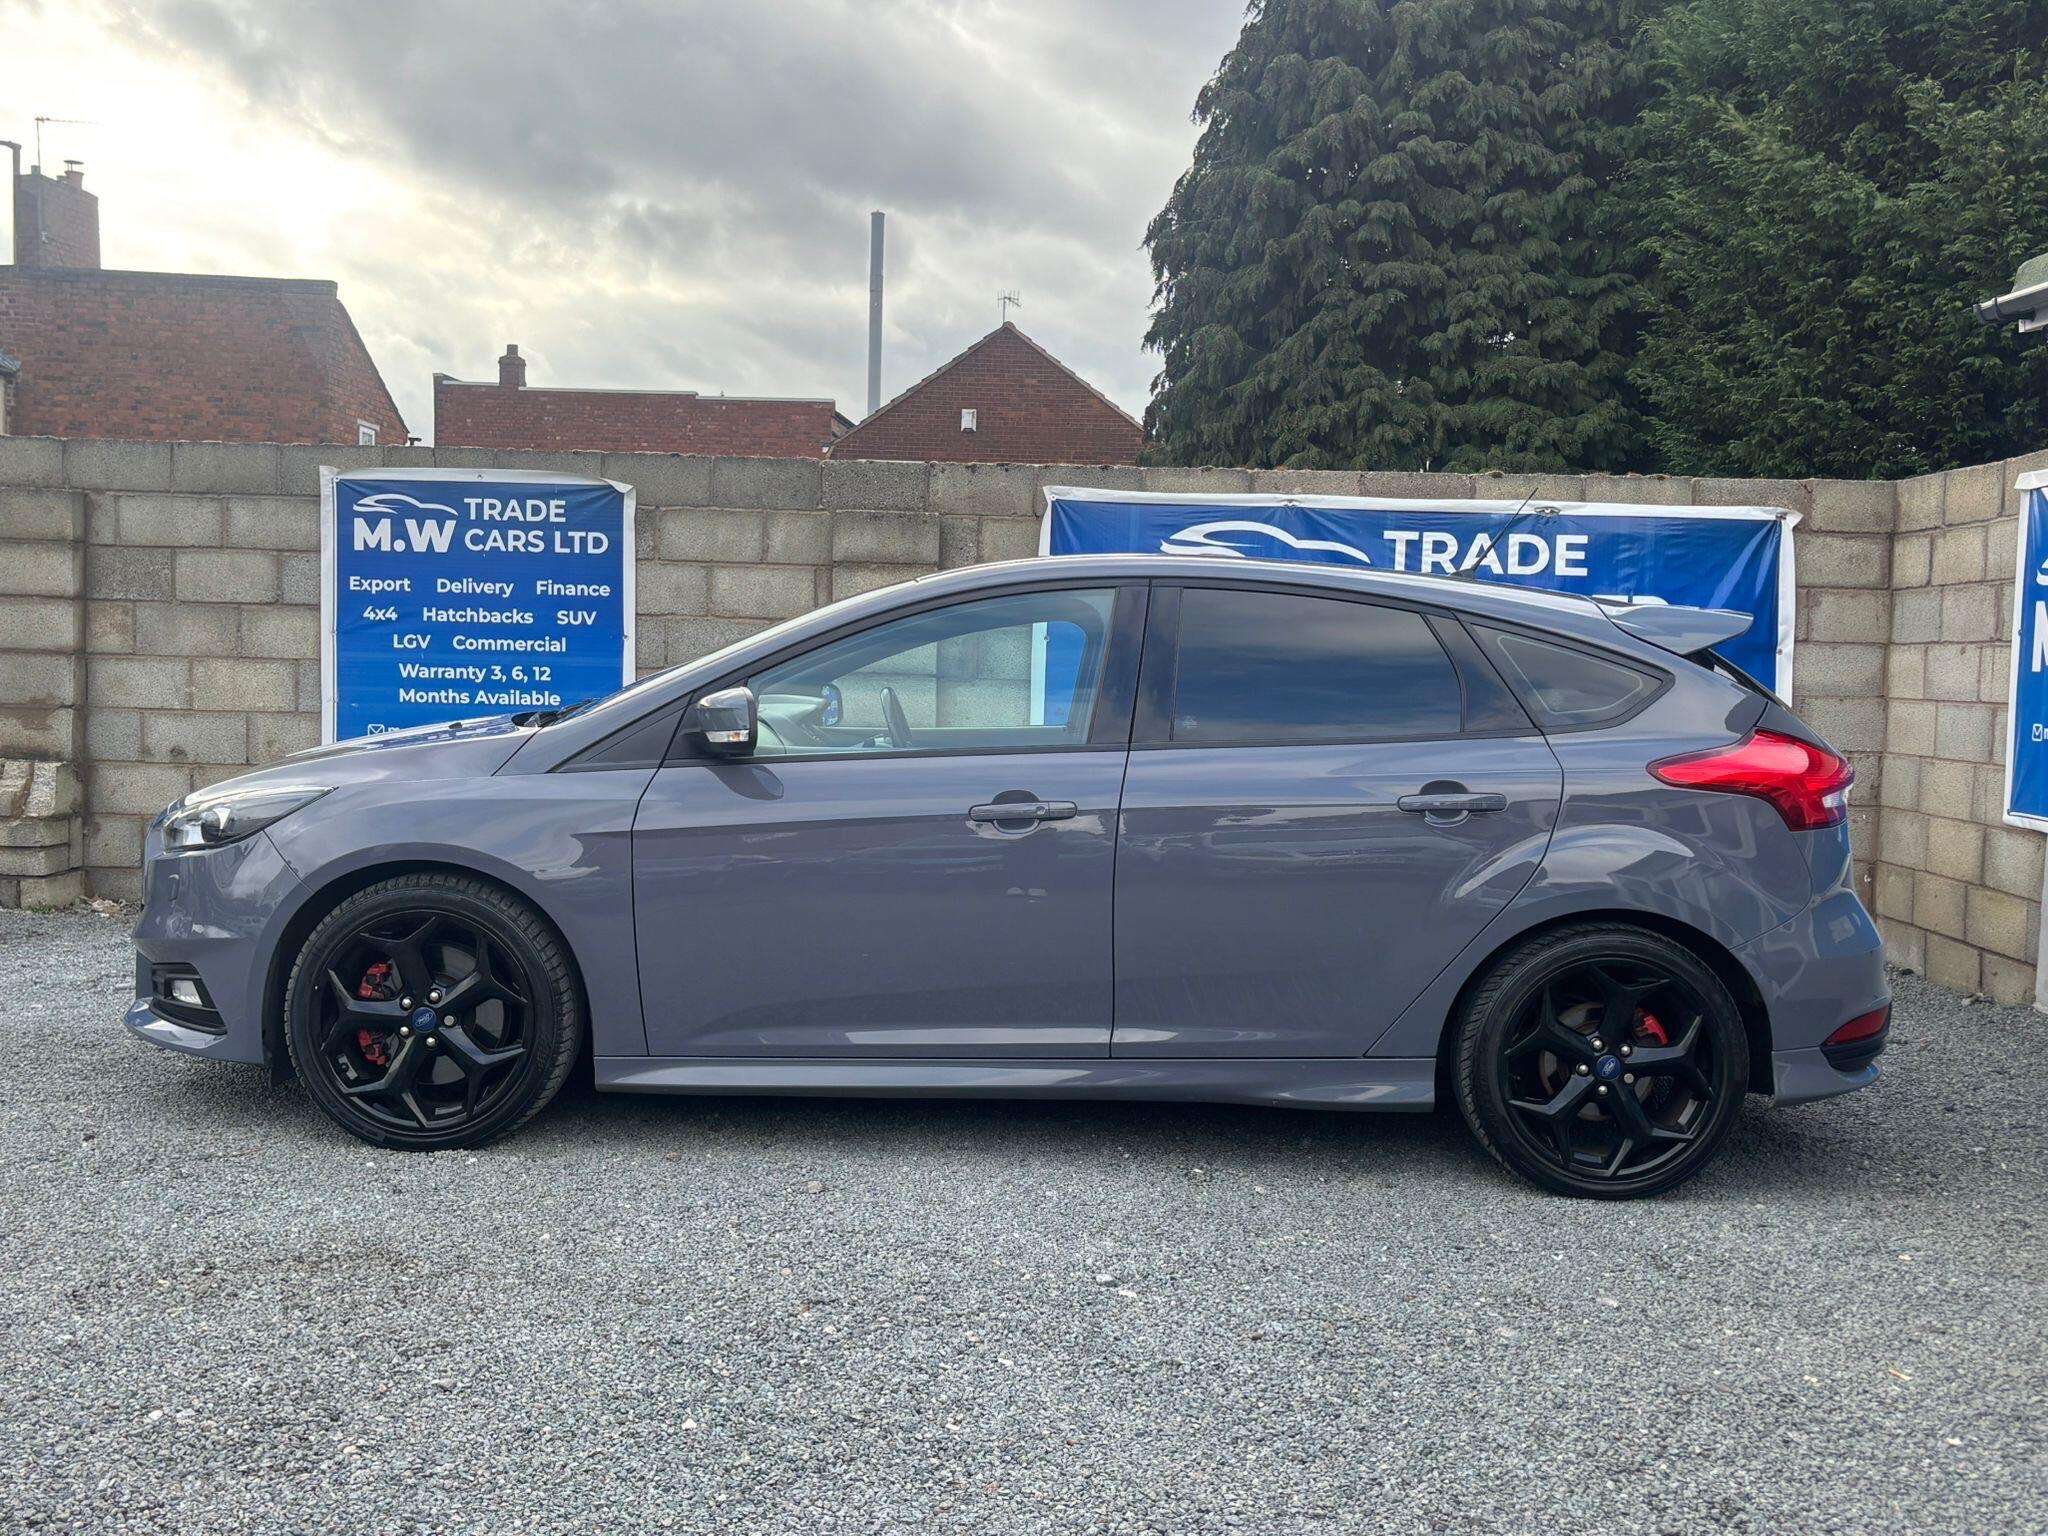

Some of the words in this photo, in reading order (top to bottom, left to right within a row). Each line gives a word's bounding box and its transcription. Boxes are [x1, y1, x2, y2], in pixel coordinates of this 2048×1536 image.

[463, 498, 566, 522] TRADE
[353, 517, 456, 552] M.W
[464, 528, 545, 553] CARS
[554, 531, 609, 554] LTD
[1383, 530, 1588, 576] TRADE
[349, 576, 411, 594] Export
[436, 578, 514, 598] Delivery
[536, 579, 610, 596] Finance
[362, 606, 398, 620] 4x4
[422, 607, 534, 624] Hatchbacks
[557, 610, 597, 625] SUV
[393, 634, 431, 649] LGV
[452, 635, 566, 652] Commercial
[399, 663, 486, 683] Warranty
[491, 666, 507, 682] 3,
[512, 666, 528, 683] 6,
[533, 666, 551, 681] 12
[399, 688, 470, 704] Months
[474, 689, 561, 706] Available
